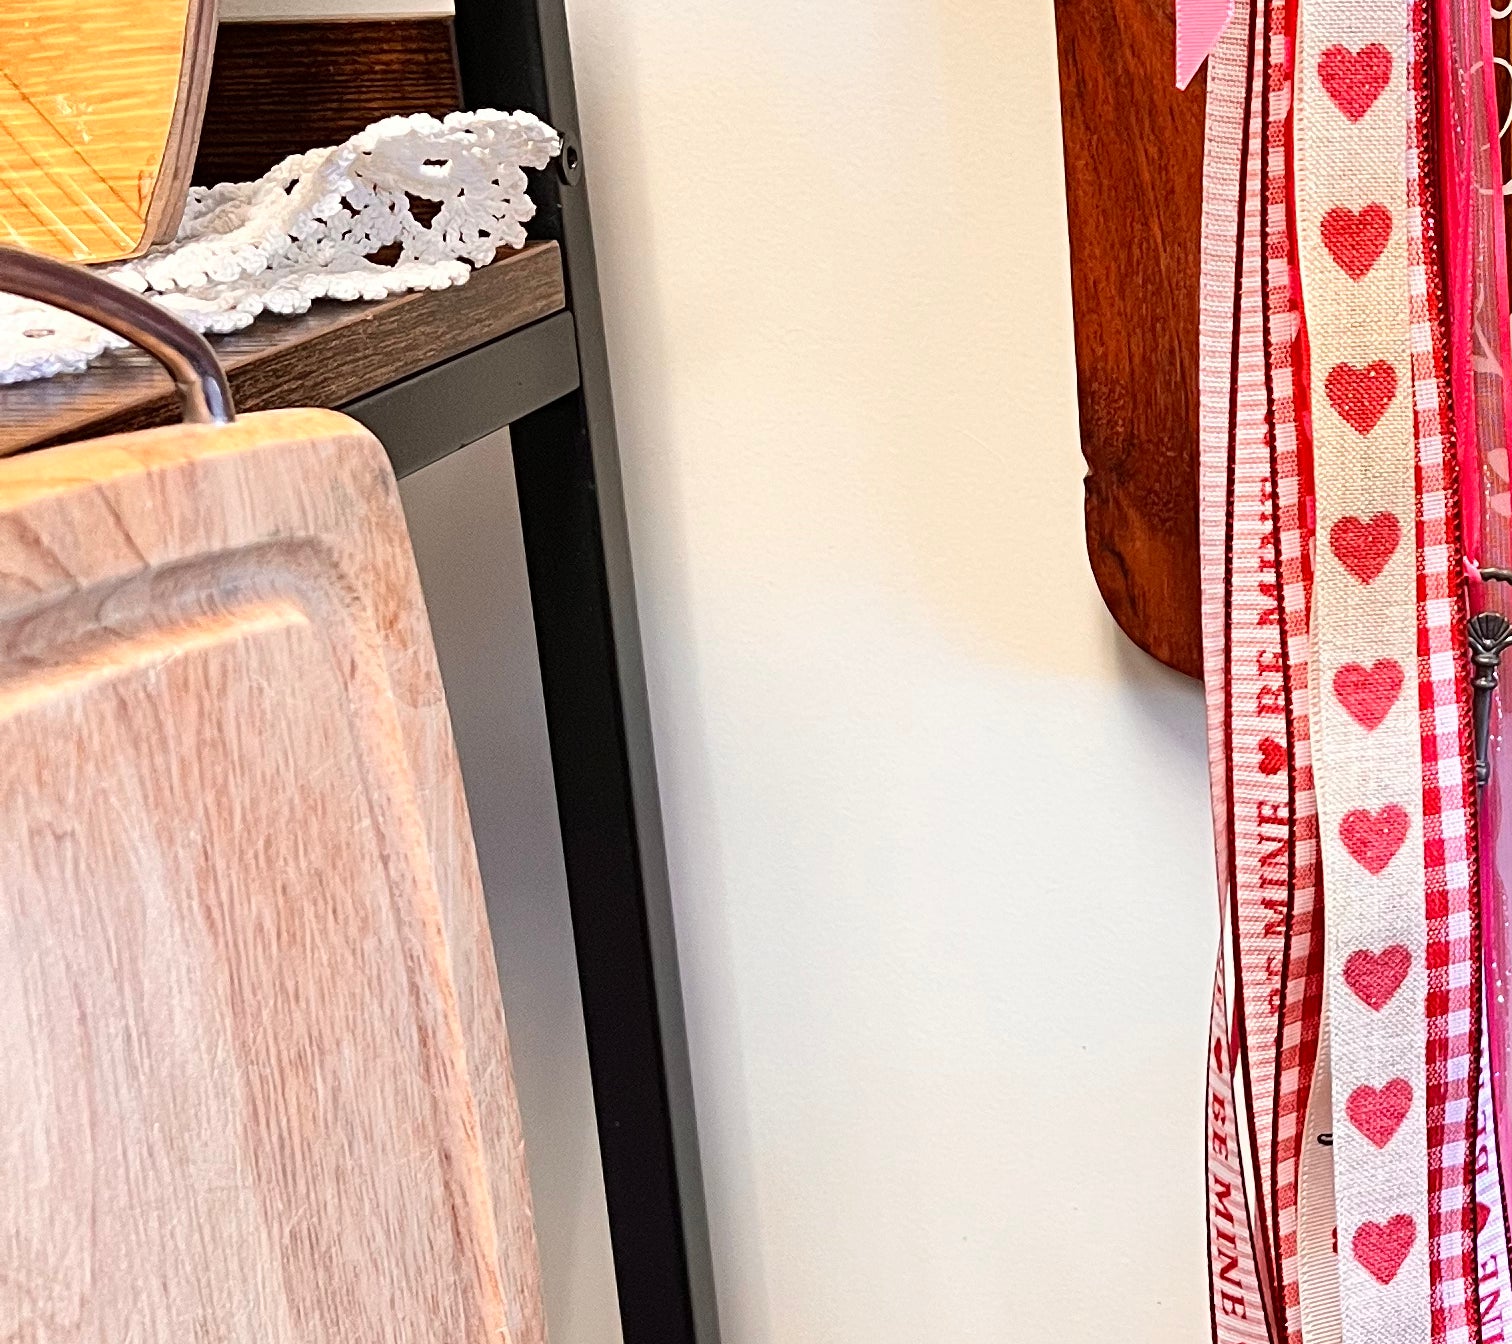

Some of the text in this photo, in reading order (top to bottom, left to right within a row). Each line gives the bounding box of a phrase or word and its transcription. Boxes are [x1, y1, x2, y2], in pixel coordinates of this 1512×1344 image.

[1256, 800, 1289, 939] MINE
[1211, 1094, 1230, 1162] BE
[1213, 1175, 1248, 1321] MINE
